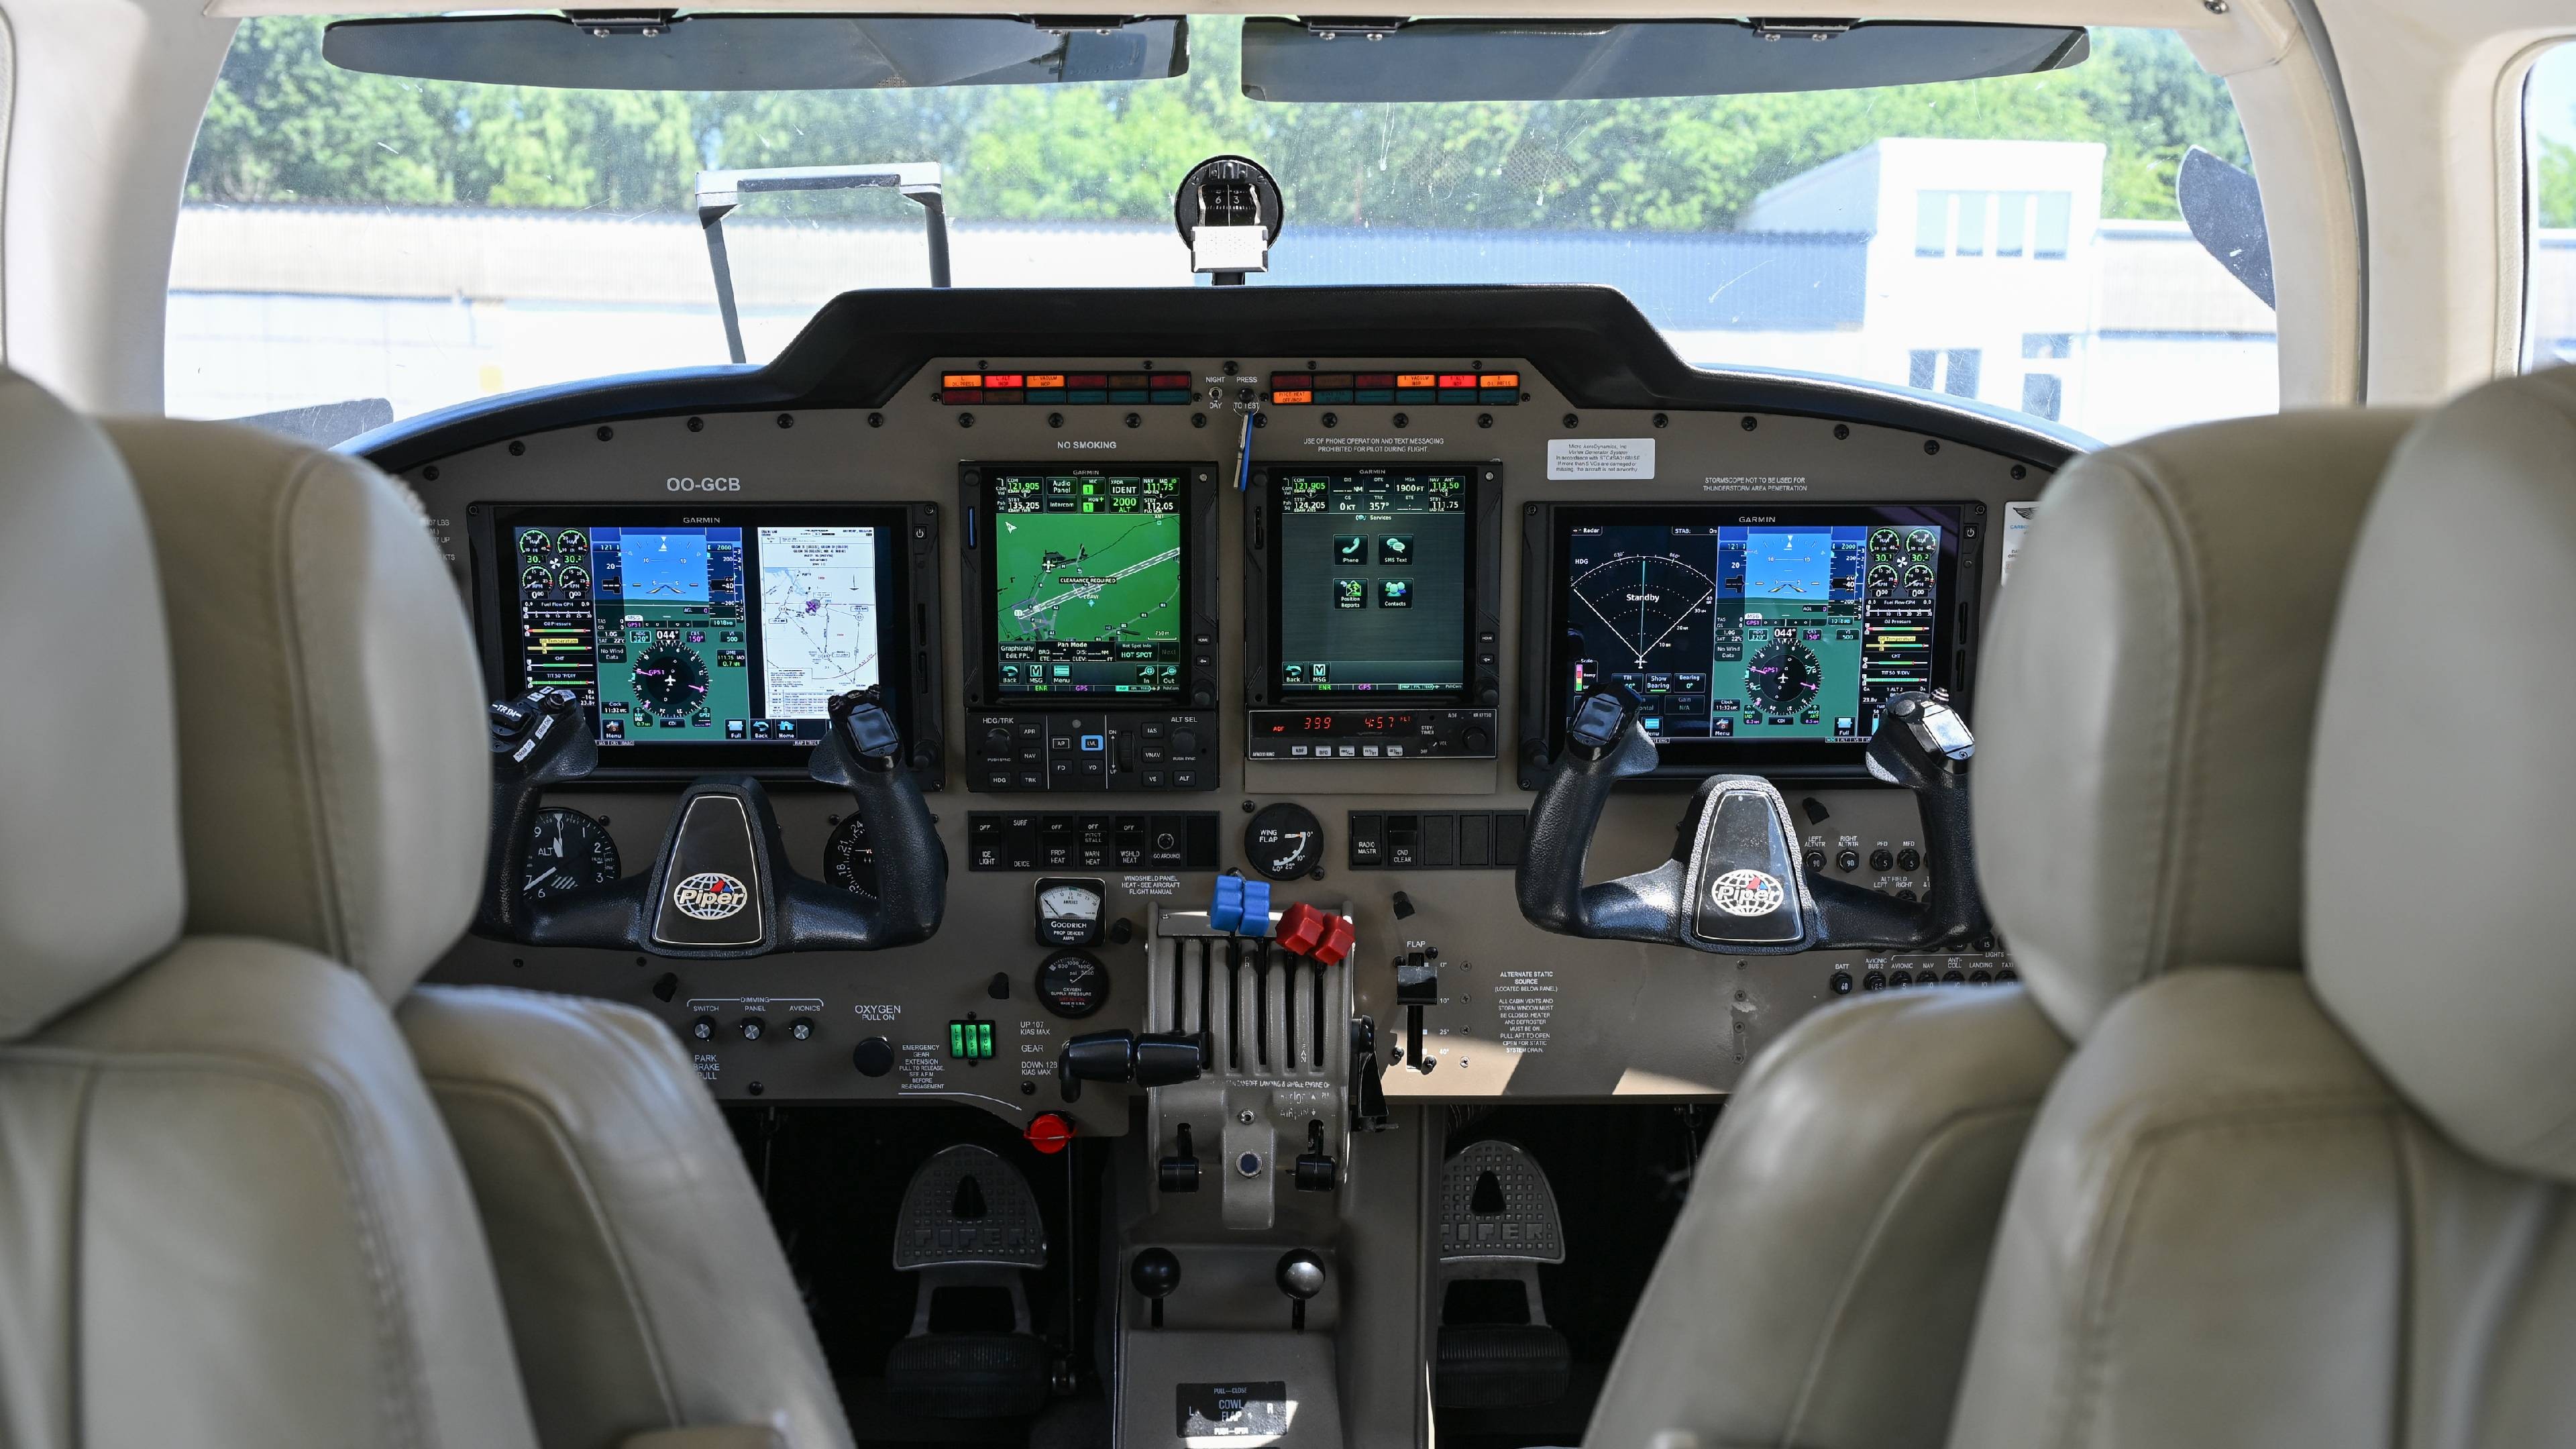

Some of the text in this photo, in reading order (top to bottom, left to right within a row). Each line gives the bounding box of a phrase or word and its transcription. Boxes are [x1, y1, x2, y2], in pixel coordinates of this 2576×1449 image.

[1057, 441, 1117, 449] NO SMOKING
[666, 477, 741, 492] OO-GCB
[1113, 498, 1136, 506] 2000
[1625, 593, 1660, 602] Standby
[1304, 717, 1332, 729] 399
[1259, 828, 1278, 837] WING
[1259, 835, 1279, 843] FLAP
[538, 847, 553, 856] ALT
[1393, 855, 1412, 863] CLEAR
[1717, 883, 1781, 904] Piper
[678, 889, 745, 909] Piper
[855, 1005, 902, 1014] OXYGEN
[1021, 1044, 1044, 1053] GEAR
[695, 1055, 716, 1063] PARK
[694, 1063, 719, 1071] BRAKE
[1219, 1399, 1244, 1409] COWL
